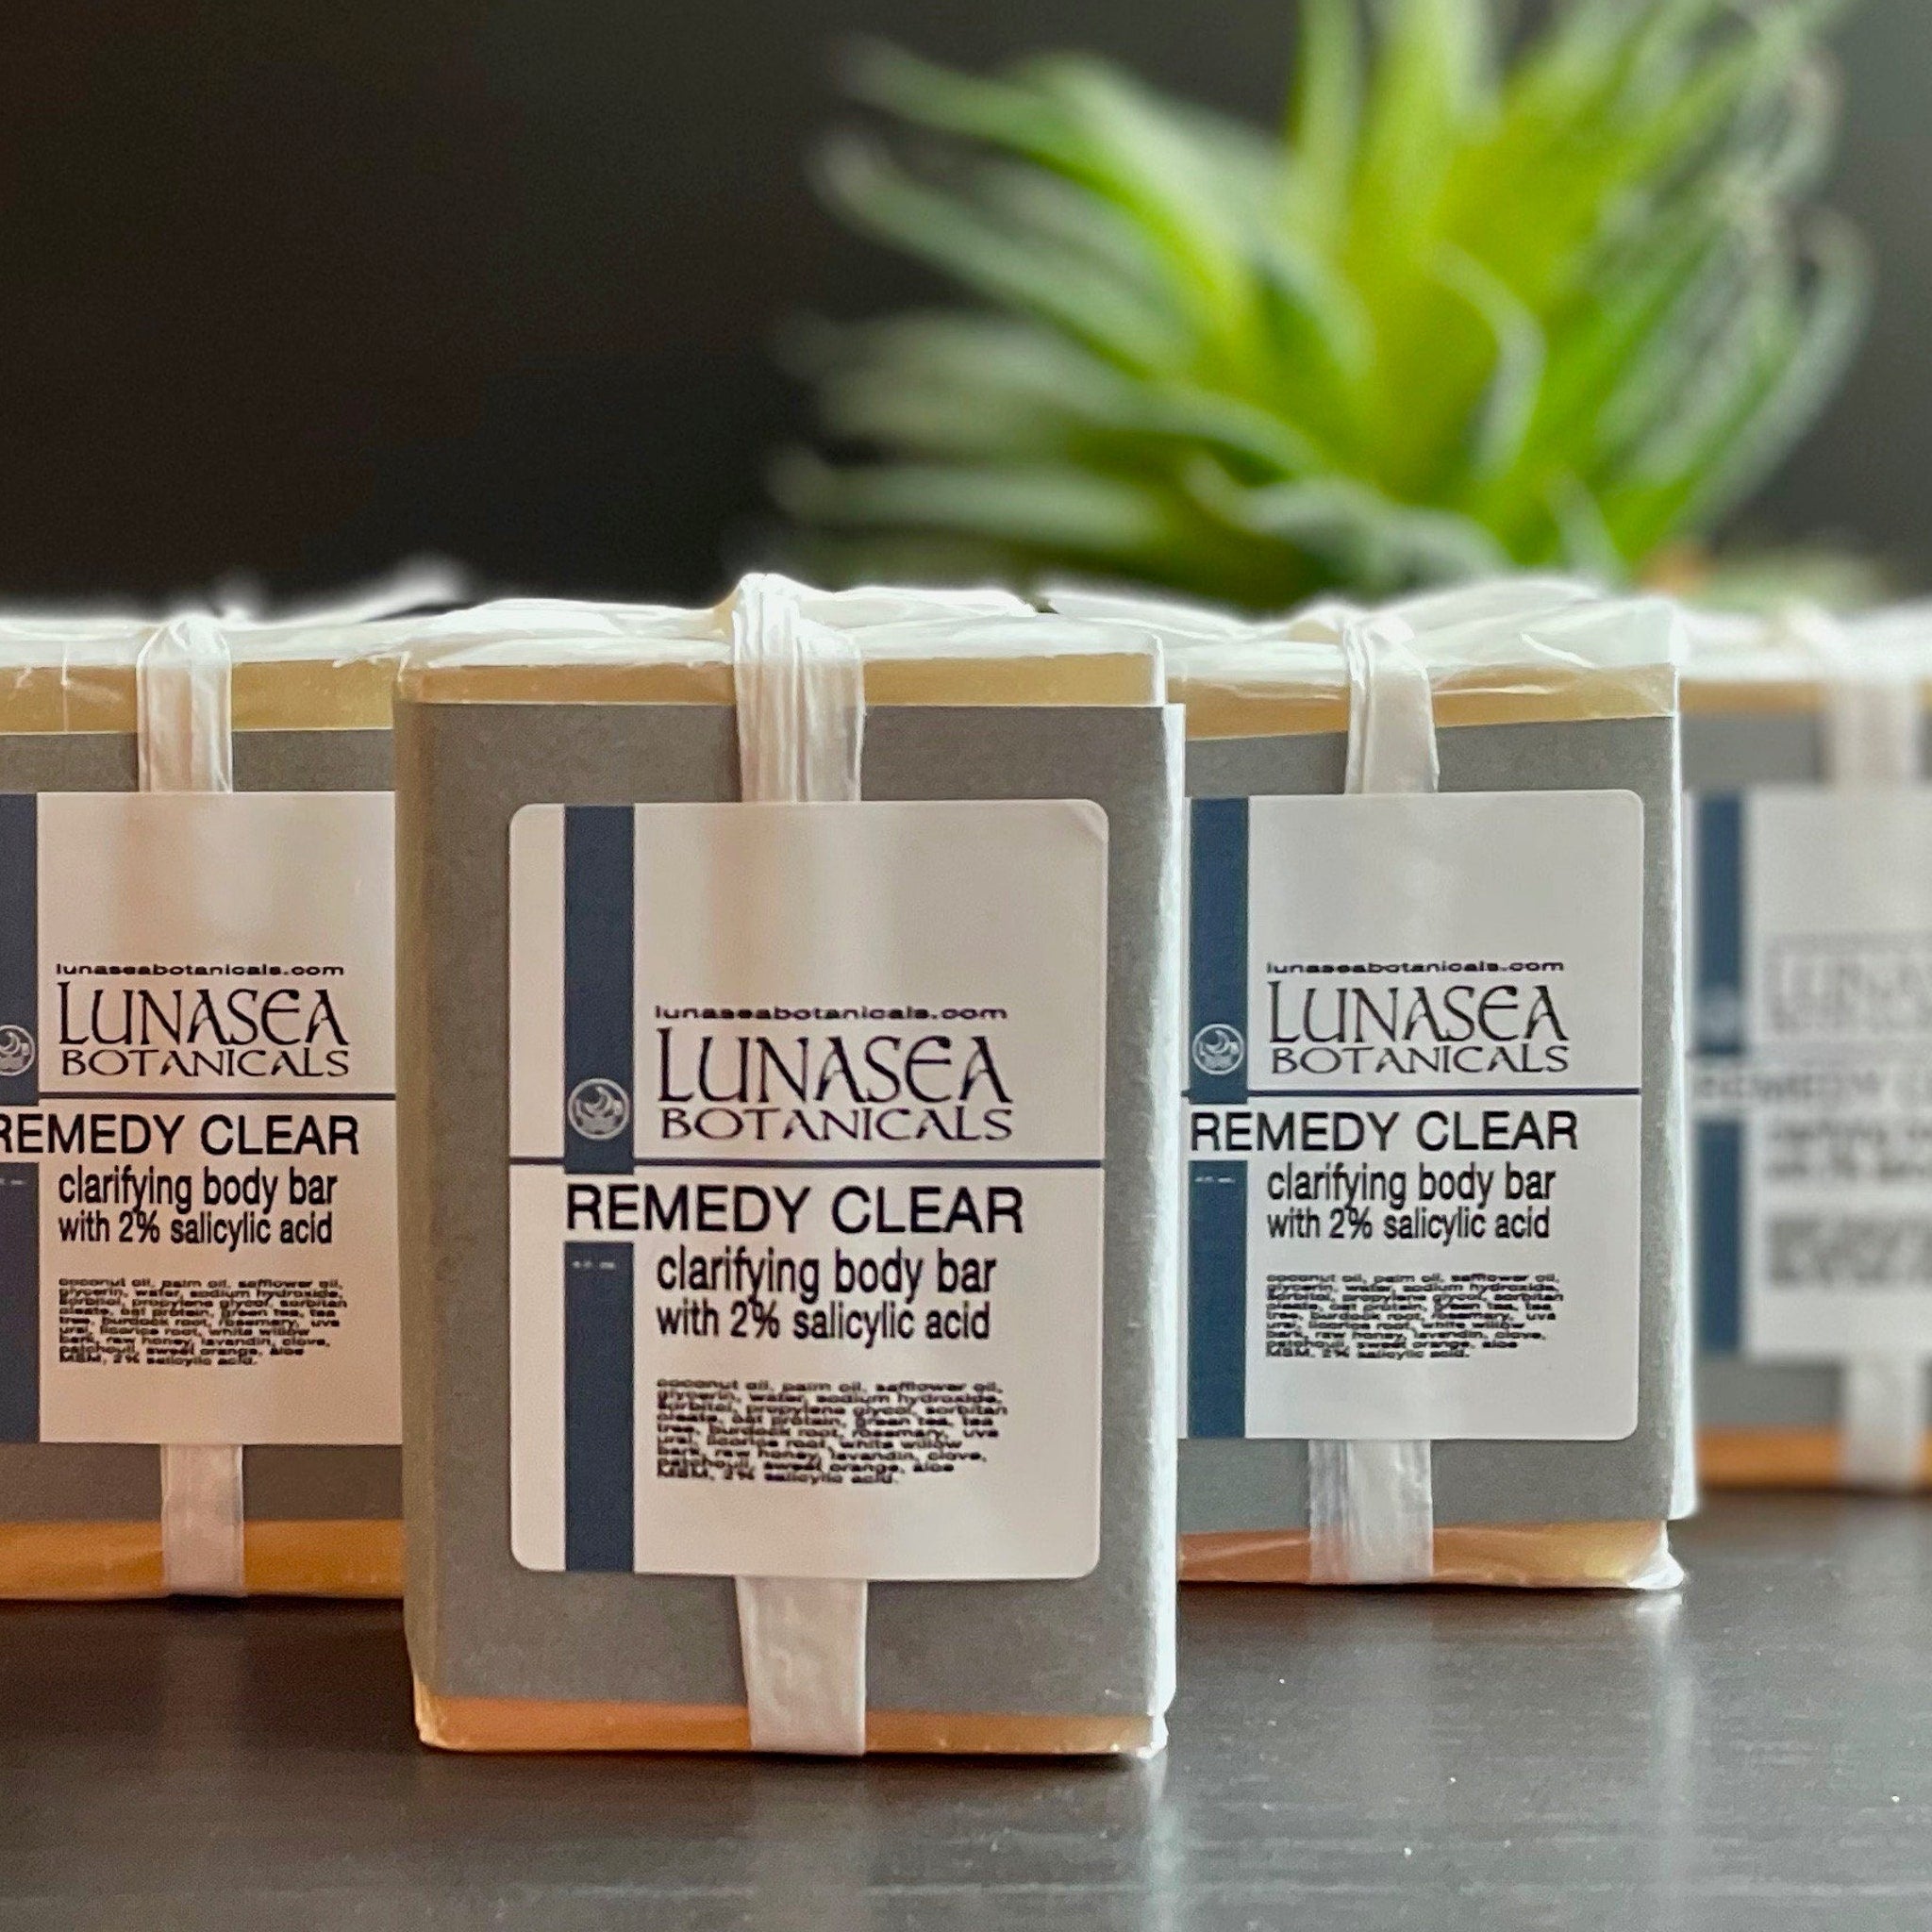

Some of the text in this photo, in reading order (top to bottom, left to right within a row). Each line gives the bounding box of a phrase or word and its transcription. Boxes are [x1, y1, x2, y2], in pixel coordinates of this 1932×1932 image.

[56, 963, 344, 976] lunaseabotanicals.com
[1266, 960, 1564, 973] lunaseabotanicals.com
[58, 980, 349, 1046] LUNASEA
[655, 1005, 1008, 1021] lunaseabotanicals.com
[1268, 980, 1569, 1043] LUNASEA
[60, 1047, 349, 1077] BOTANICALS
[657, 1026, 1014, 1105] LUNASEA
[1272, 1044, 1569, 1074] BOTANICALS
[201, 1113, 359, 1156] CLEAR
[661, 1106, 1013, 1141] BOTANICALS
[1191, 1109, 1578, 1151] REMEDY CLEAR
[58, 1166, 339, 1216] clarifying body bar
[1268, 1162, 1557, 1211] clarifying body bar
[566, 1183, 1024, 1234] REMEDY CLEAR
[1268, 1206, 1549, 1246] with 2% salicylic acid
[58, 1210, 332, 1252] with 2% salicylic acid
[657, 1245, 997, 1306] clarifying body bar
[658, 1296, 990, 1349] with 2% salicylic acid
